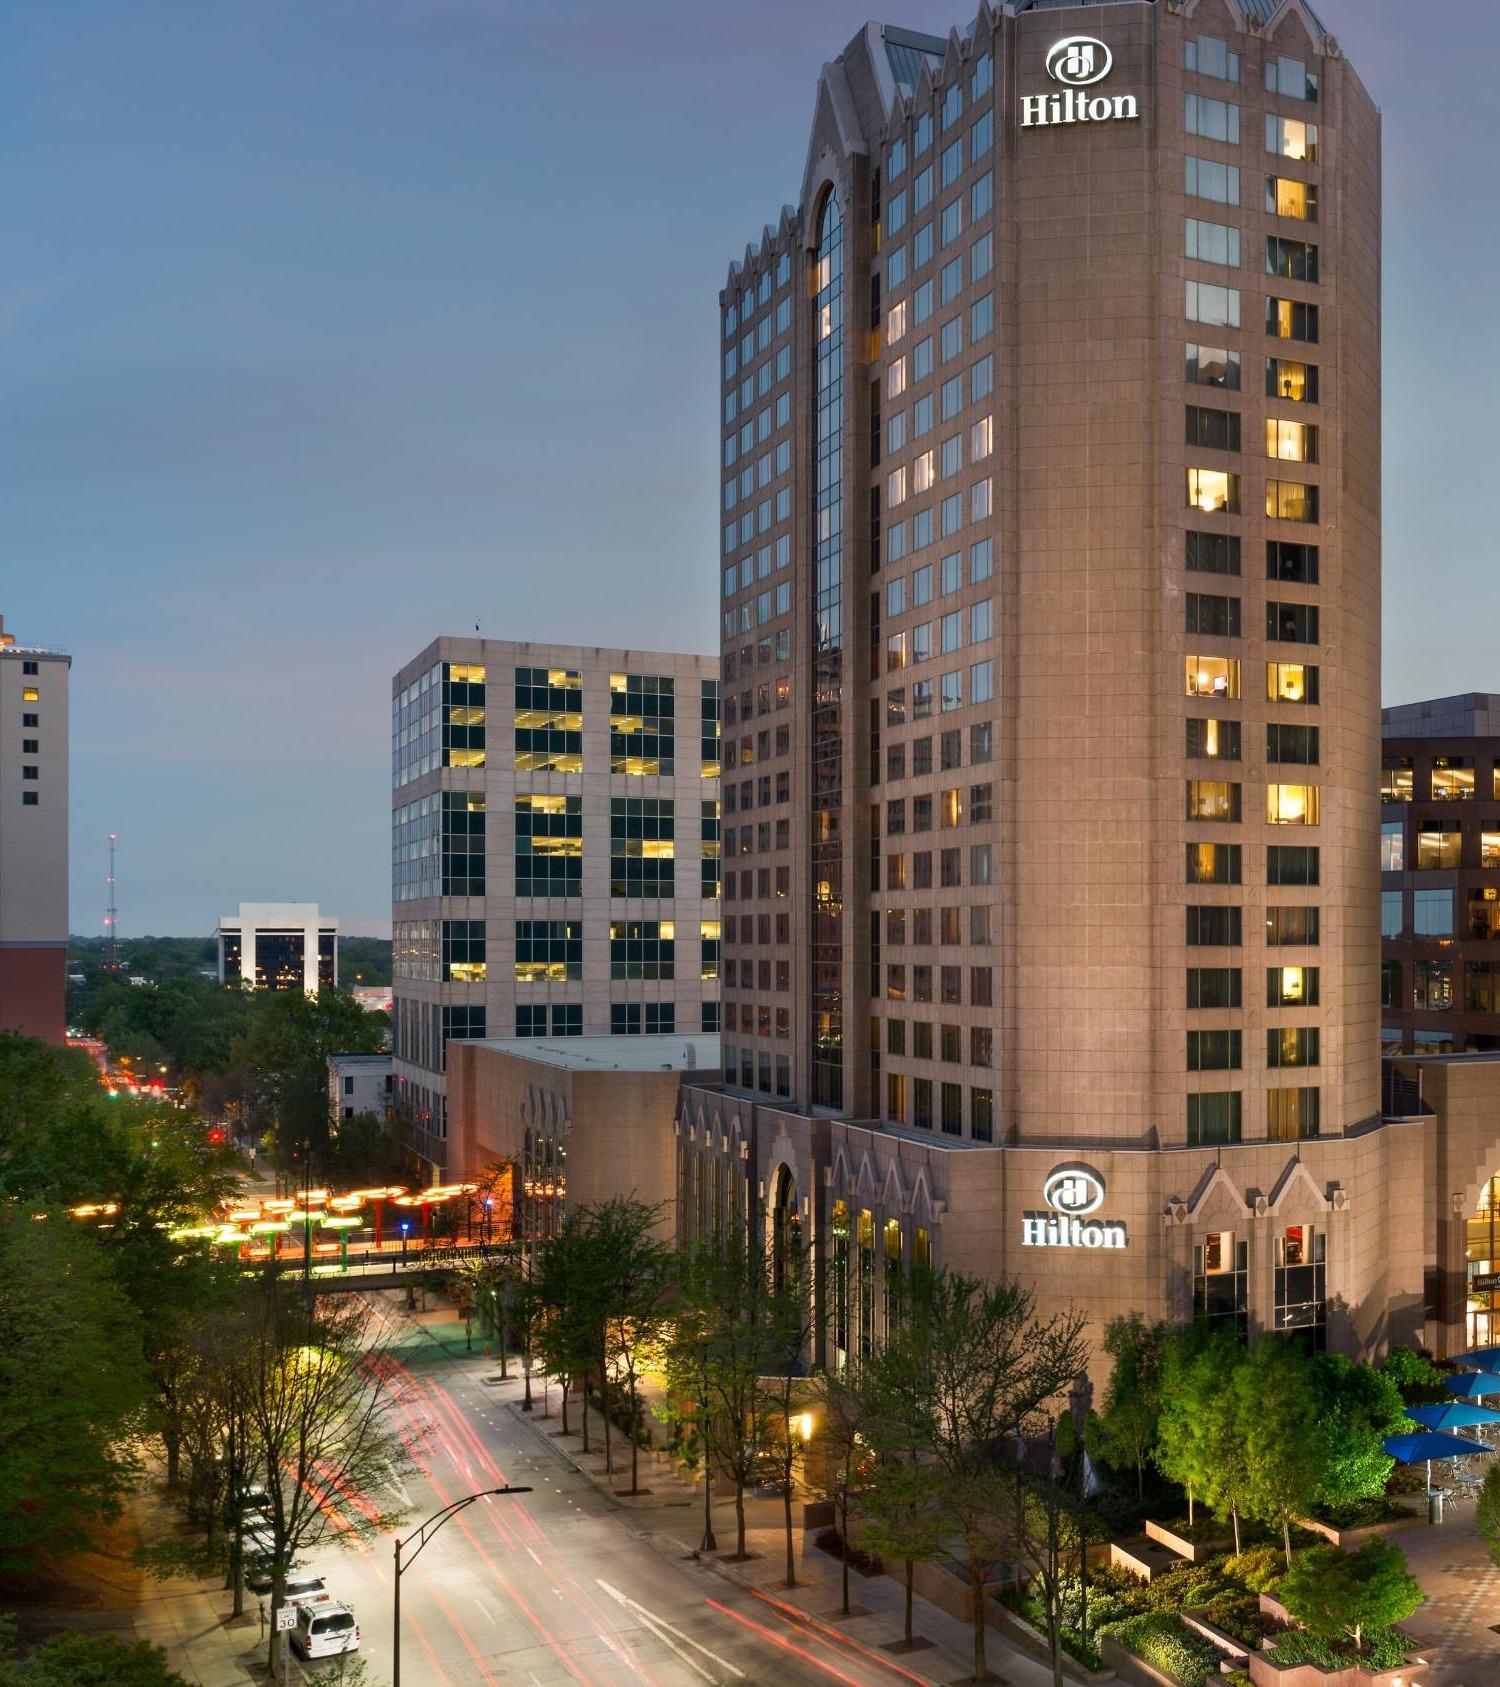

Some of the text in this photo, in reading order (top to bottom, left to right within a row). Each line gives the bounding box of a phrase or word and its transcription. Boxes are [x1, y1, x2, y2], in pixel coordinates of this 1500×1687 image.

[1020, 89, 1139, 127] Hilton
[1022, 1216, 1127, 1248] Hilton
[279, 1618, 295, 1629] 30
